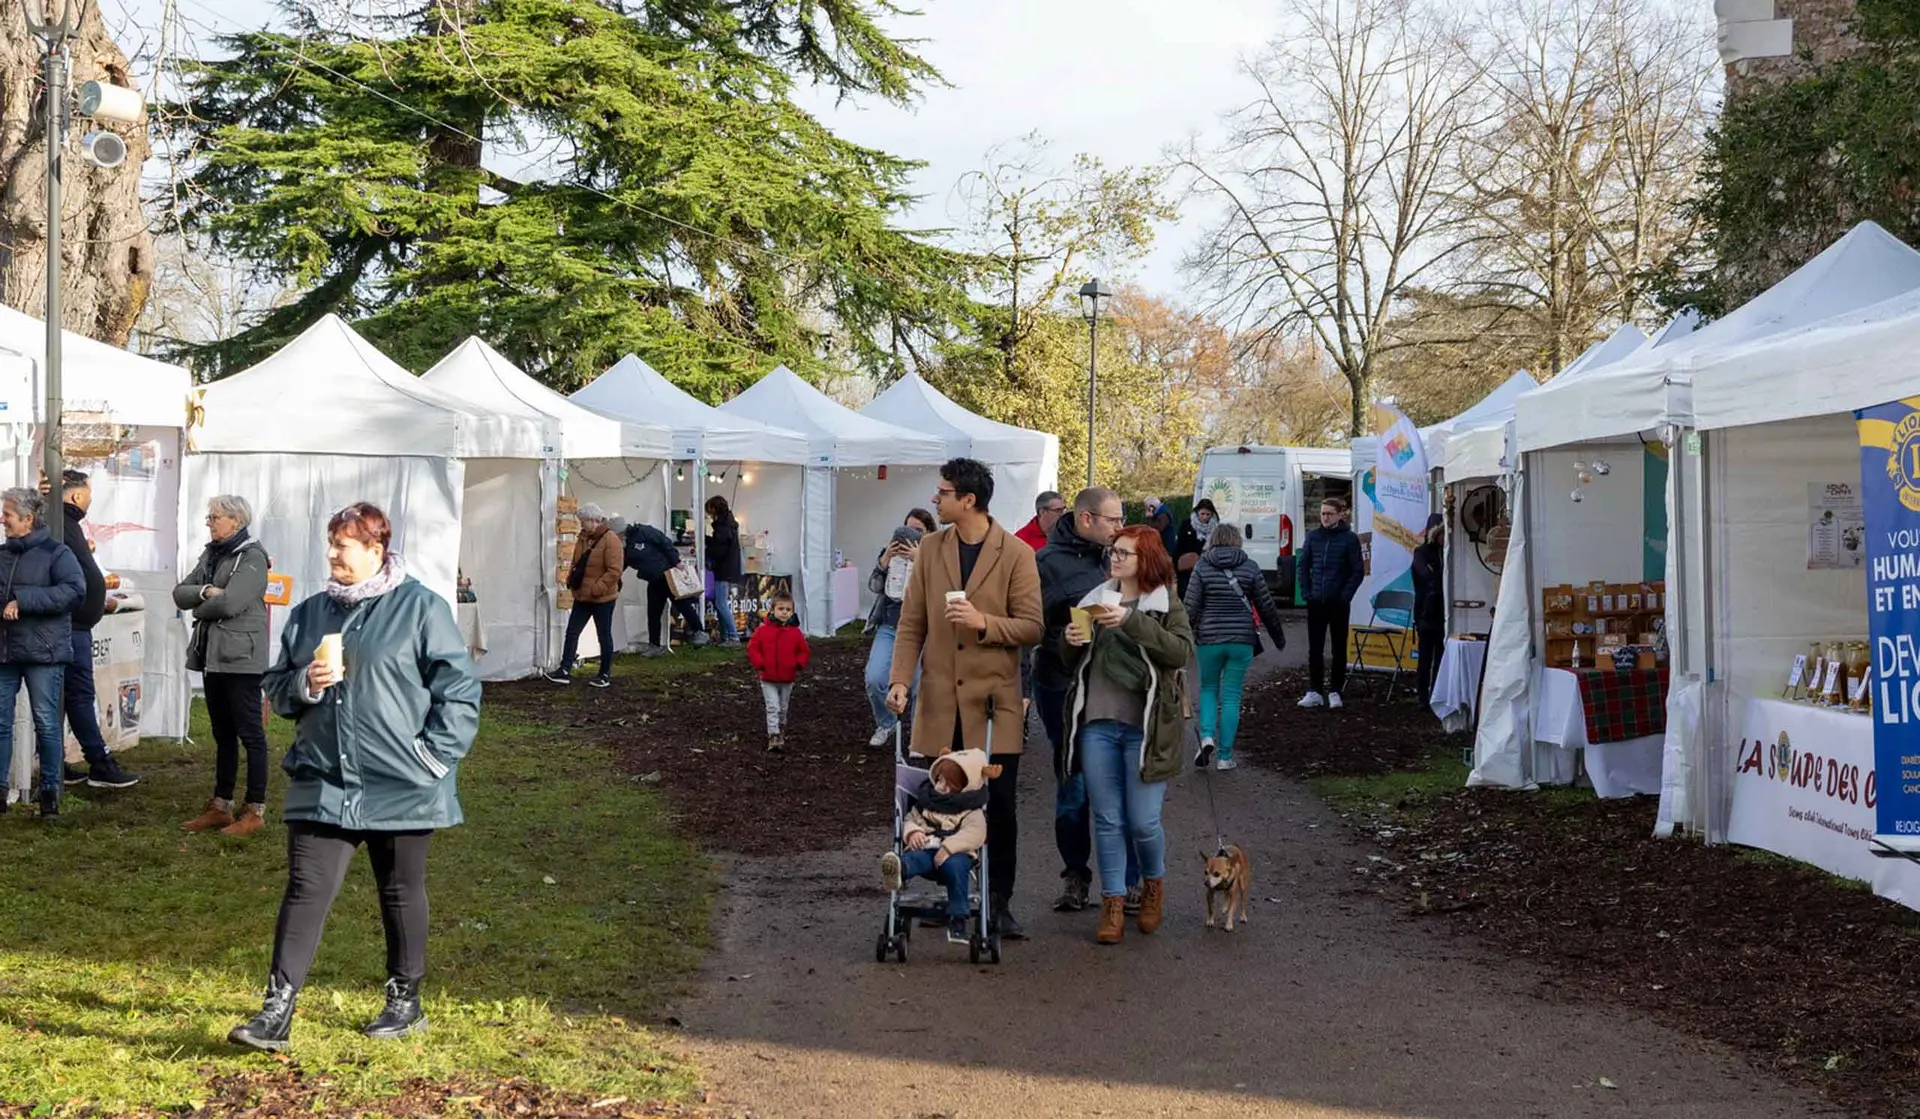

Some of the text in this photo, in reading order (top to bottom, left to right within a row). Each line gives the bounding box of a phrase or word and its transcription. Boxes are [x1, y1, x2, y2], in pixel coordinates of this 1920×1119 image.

[1898, 414, 1920, 440] LIO
[1887, 529, 1920, 549] VOU
[1875, 586, 1895, 613] ET
[1736, 738, 1763, 777] LA
[1825, 758, 1859, 805] DES
